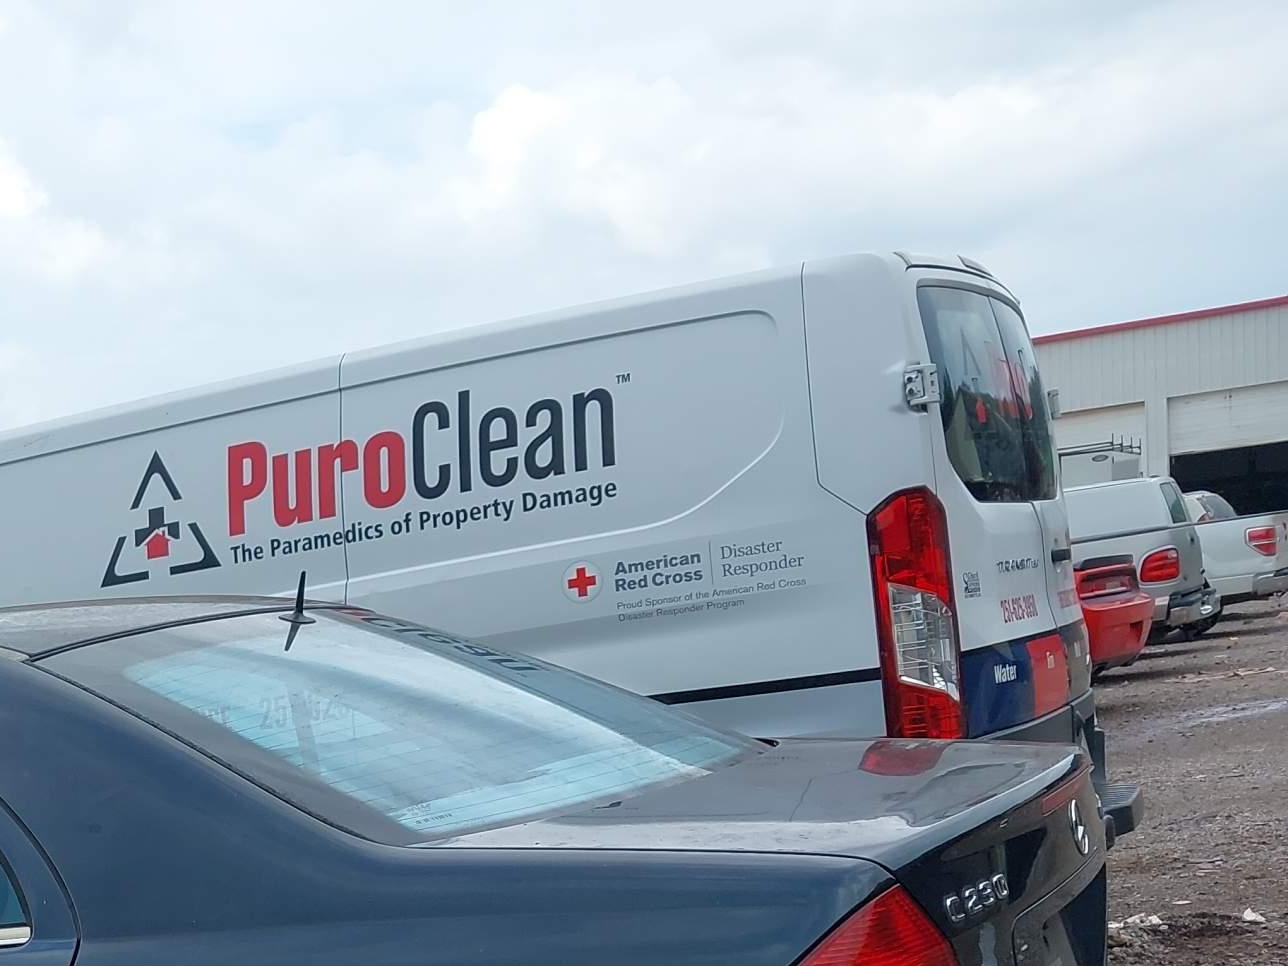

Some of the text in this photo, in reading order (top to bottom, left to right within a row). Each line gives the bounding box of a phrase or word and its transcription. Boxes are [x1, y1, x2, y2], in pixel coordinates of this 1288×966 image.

[227, 387, 617, 537] PuroClean
[230, 481, 618, 565] The Paramedics of Property Damage
[719, 539, 784, 560] Disaster
[614, 552, 702, 576] American
[721, 554, 806, 578] Responder
[614, 568, 704, 593] Red Cross
[616, 578, 807, 610] Proud Sponsor of the American Red Cross
[656, 604, 704, 617] Responder
[706, 599, 745, 611] Program
[993, 663, 1018, 684] Water
